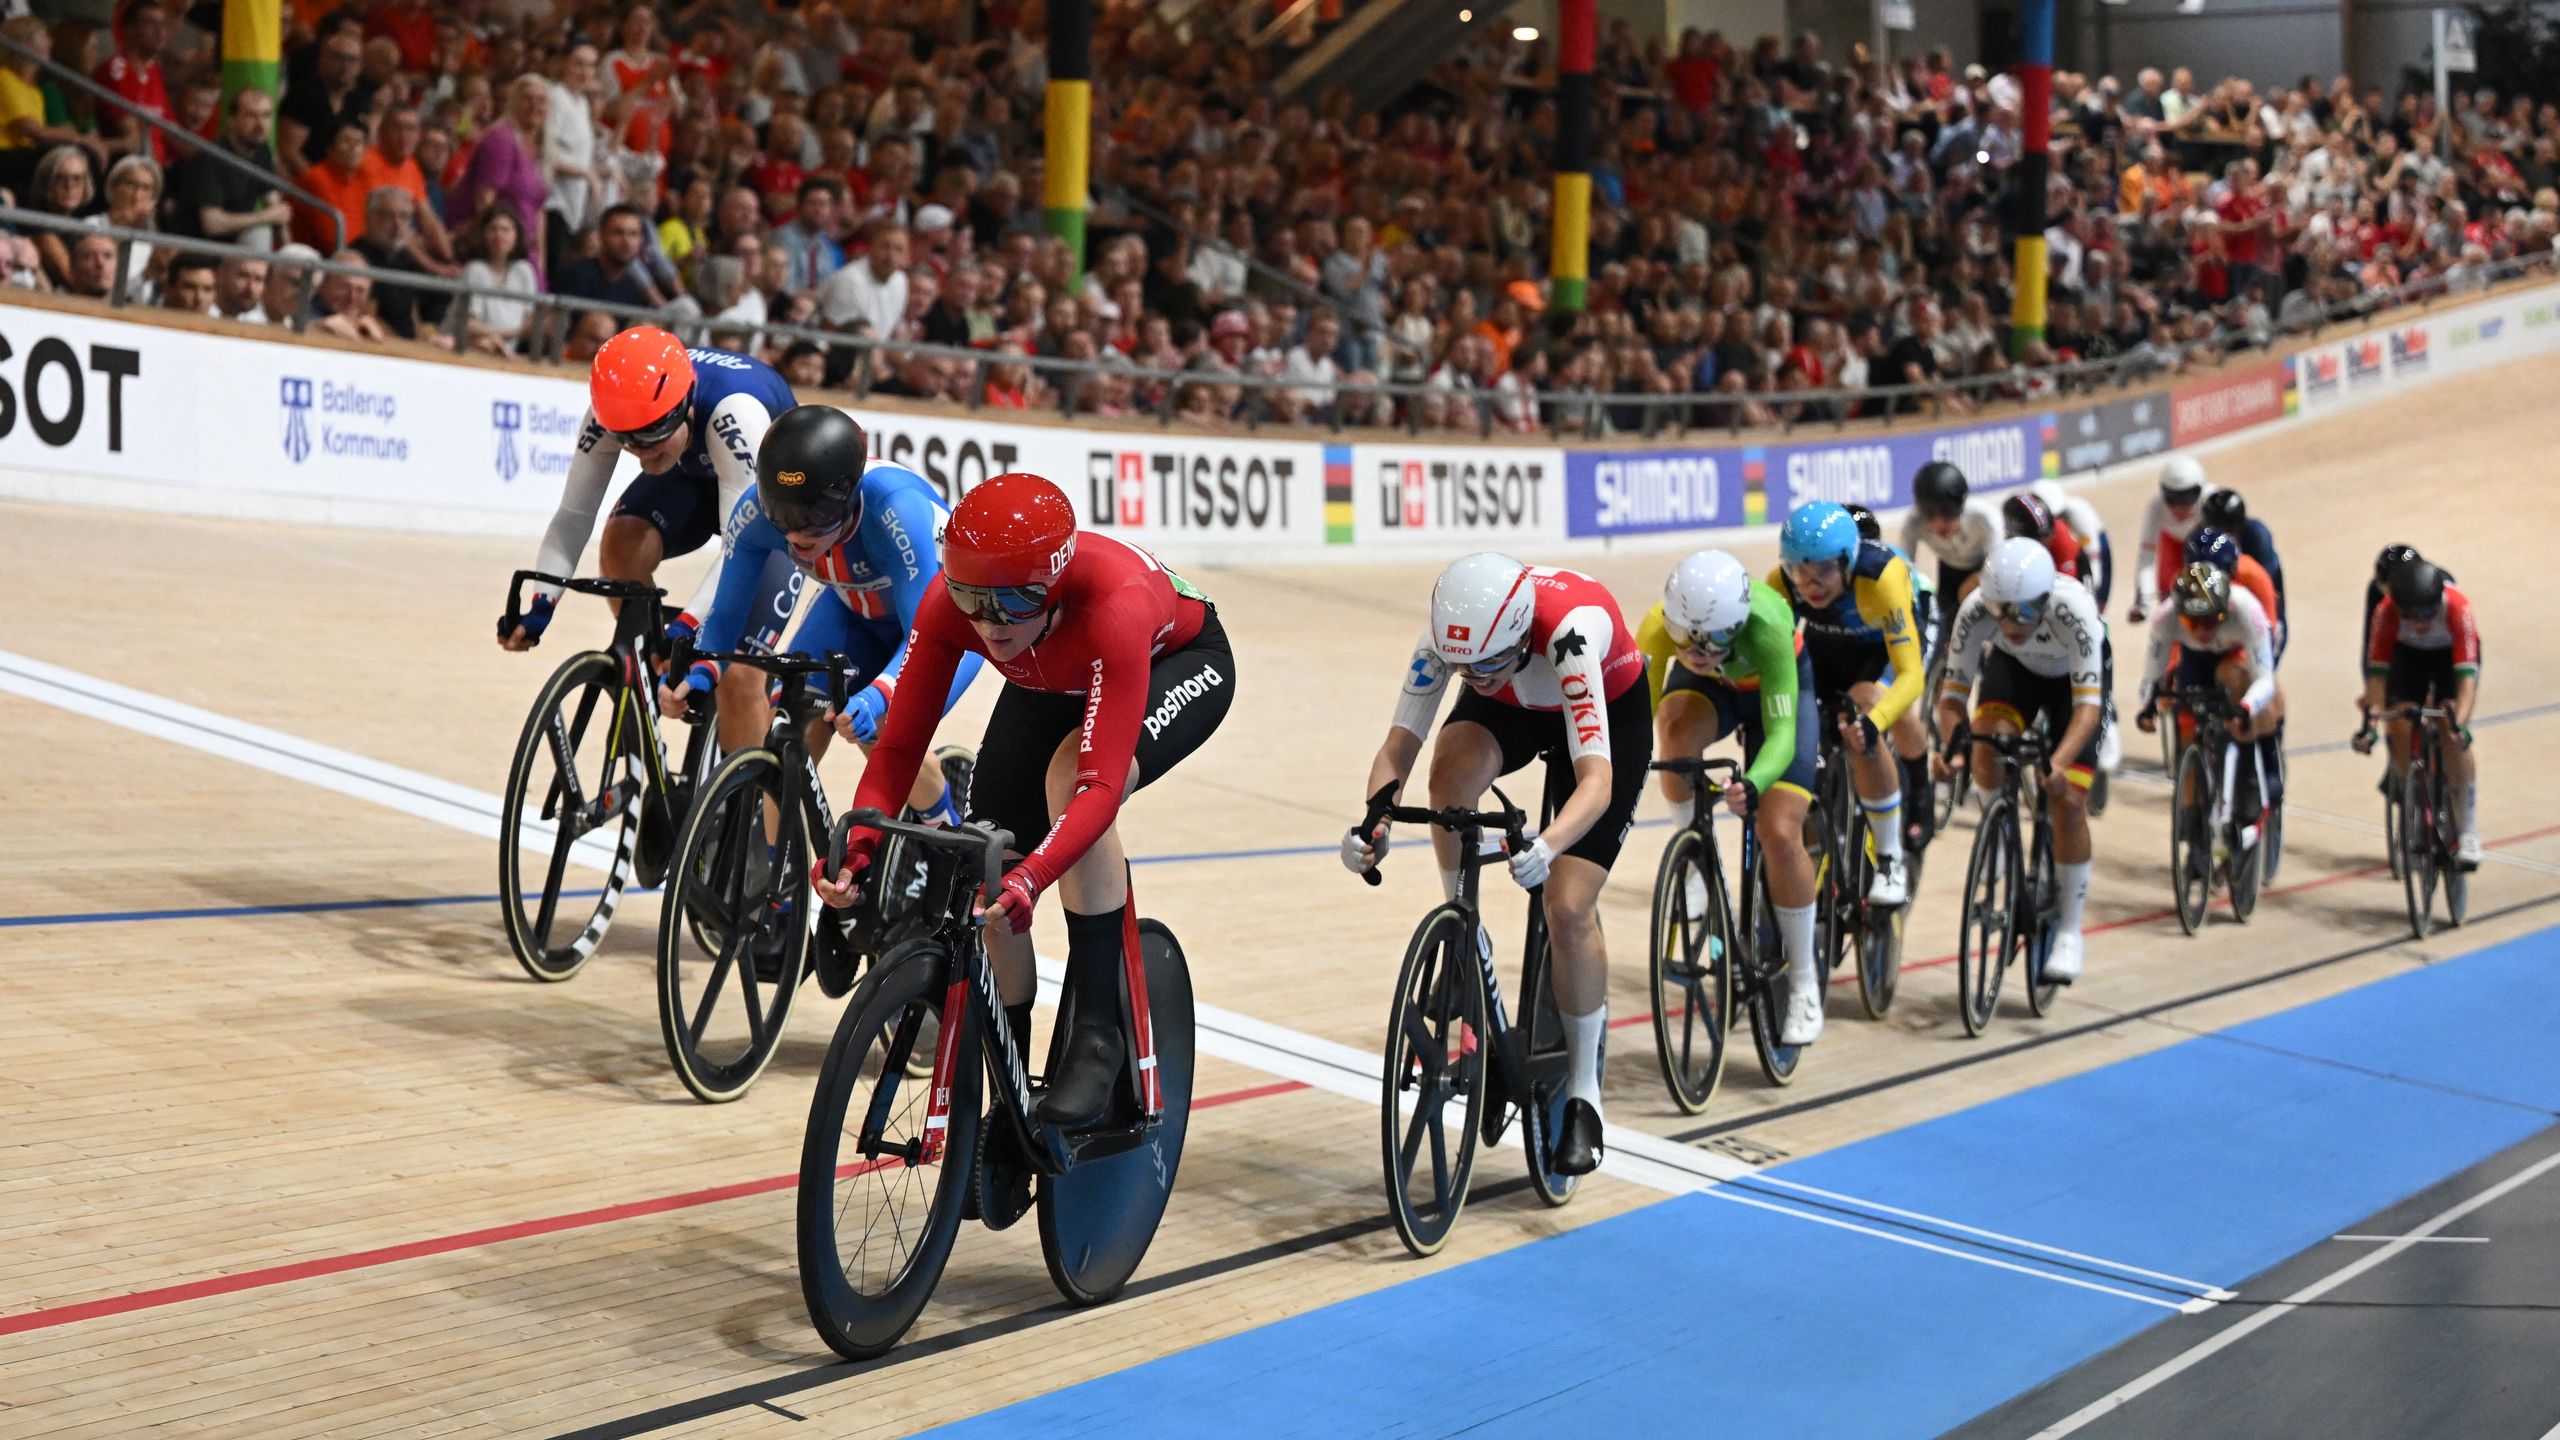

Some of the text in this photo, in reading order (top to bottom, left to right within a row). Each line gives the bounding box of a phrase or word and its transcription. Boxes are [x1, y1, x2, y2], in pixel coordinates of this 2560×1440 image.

[321, 380, 396, 420] Ballerup
[529, 403, 580, 435] Baller
[321, 424, 409, 461] Kommune
[578, 417, 606, 453] SK
[1151, 452, 1294, 530] TISSOT
[1430, 462, 1545, 528] TISSOT
[1594, 457, 1720, 526] SHIMANO
[1786, 446, 1893, 508] SHIMANO
[724, 500, 760, 560] sazka
[1050, 535, 1077, 576] DEN
[1443, 644, 1473, 656] GIRO
[2054, 602, 2095, 659] Cofidis
[1004, 663, 1024, 673] DCU
[1080, 658, 1103, 753] postnord
[1143, 663, 1224, 740] postnord
[805, 754, 836, 841] PINAR
